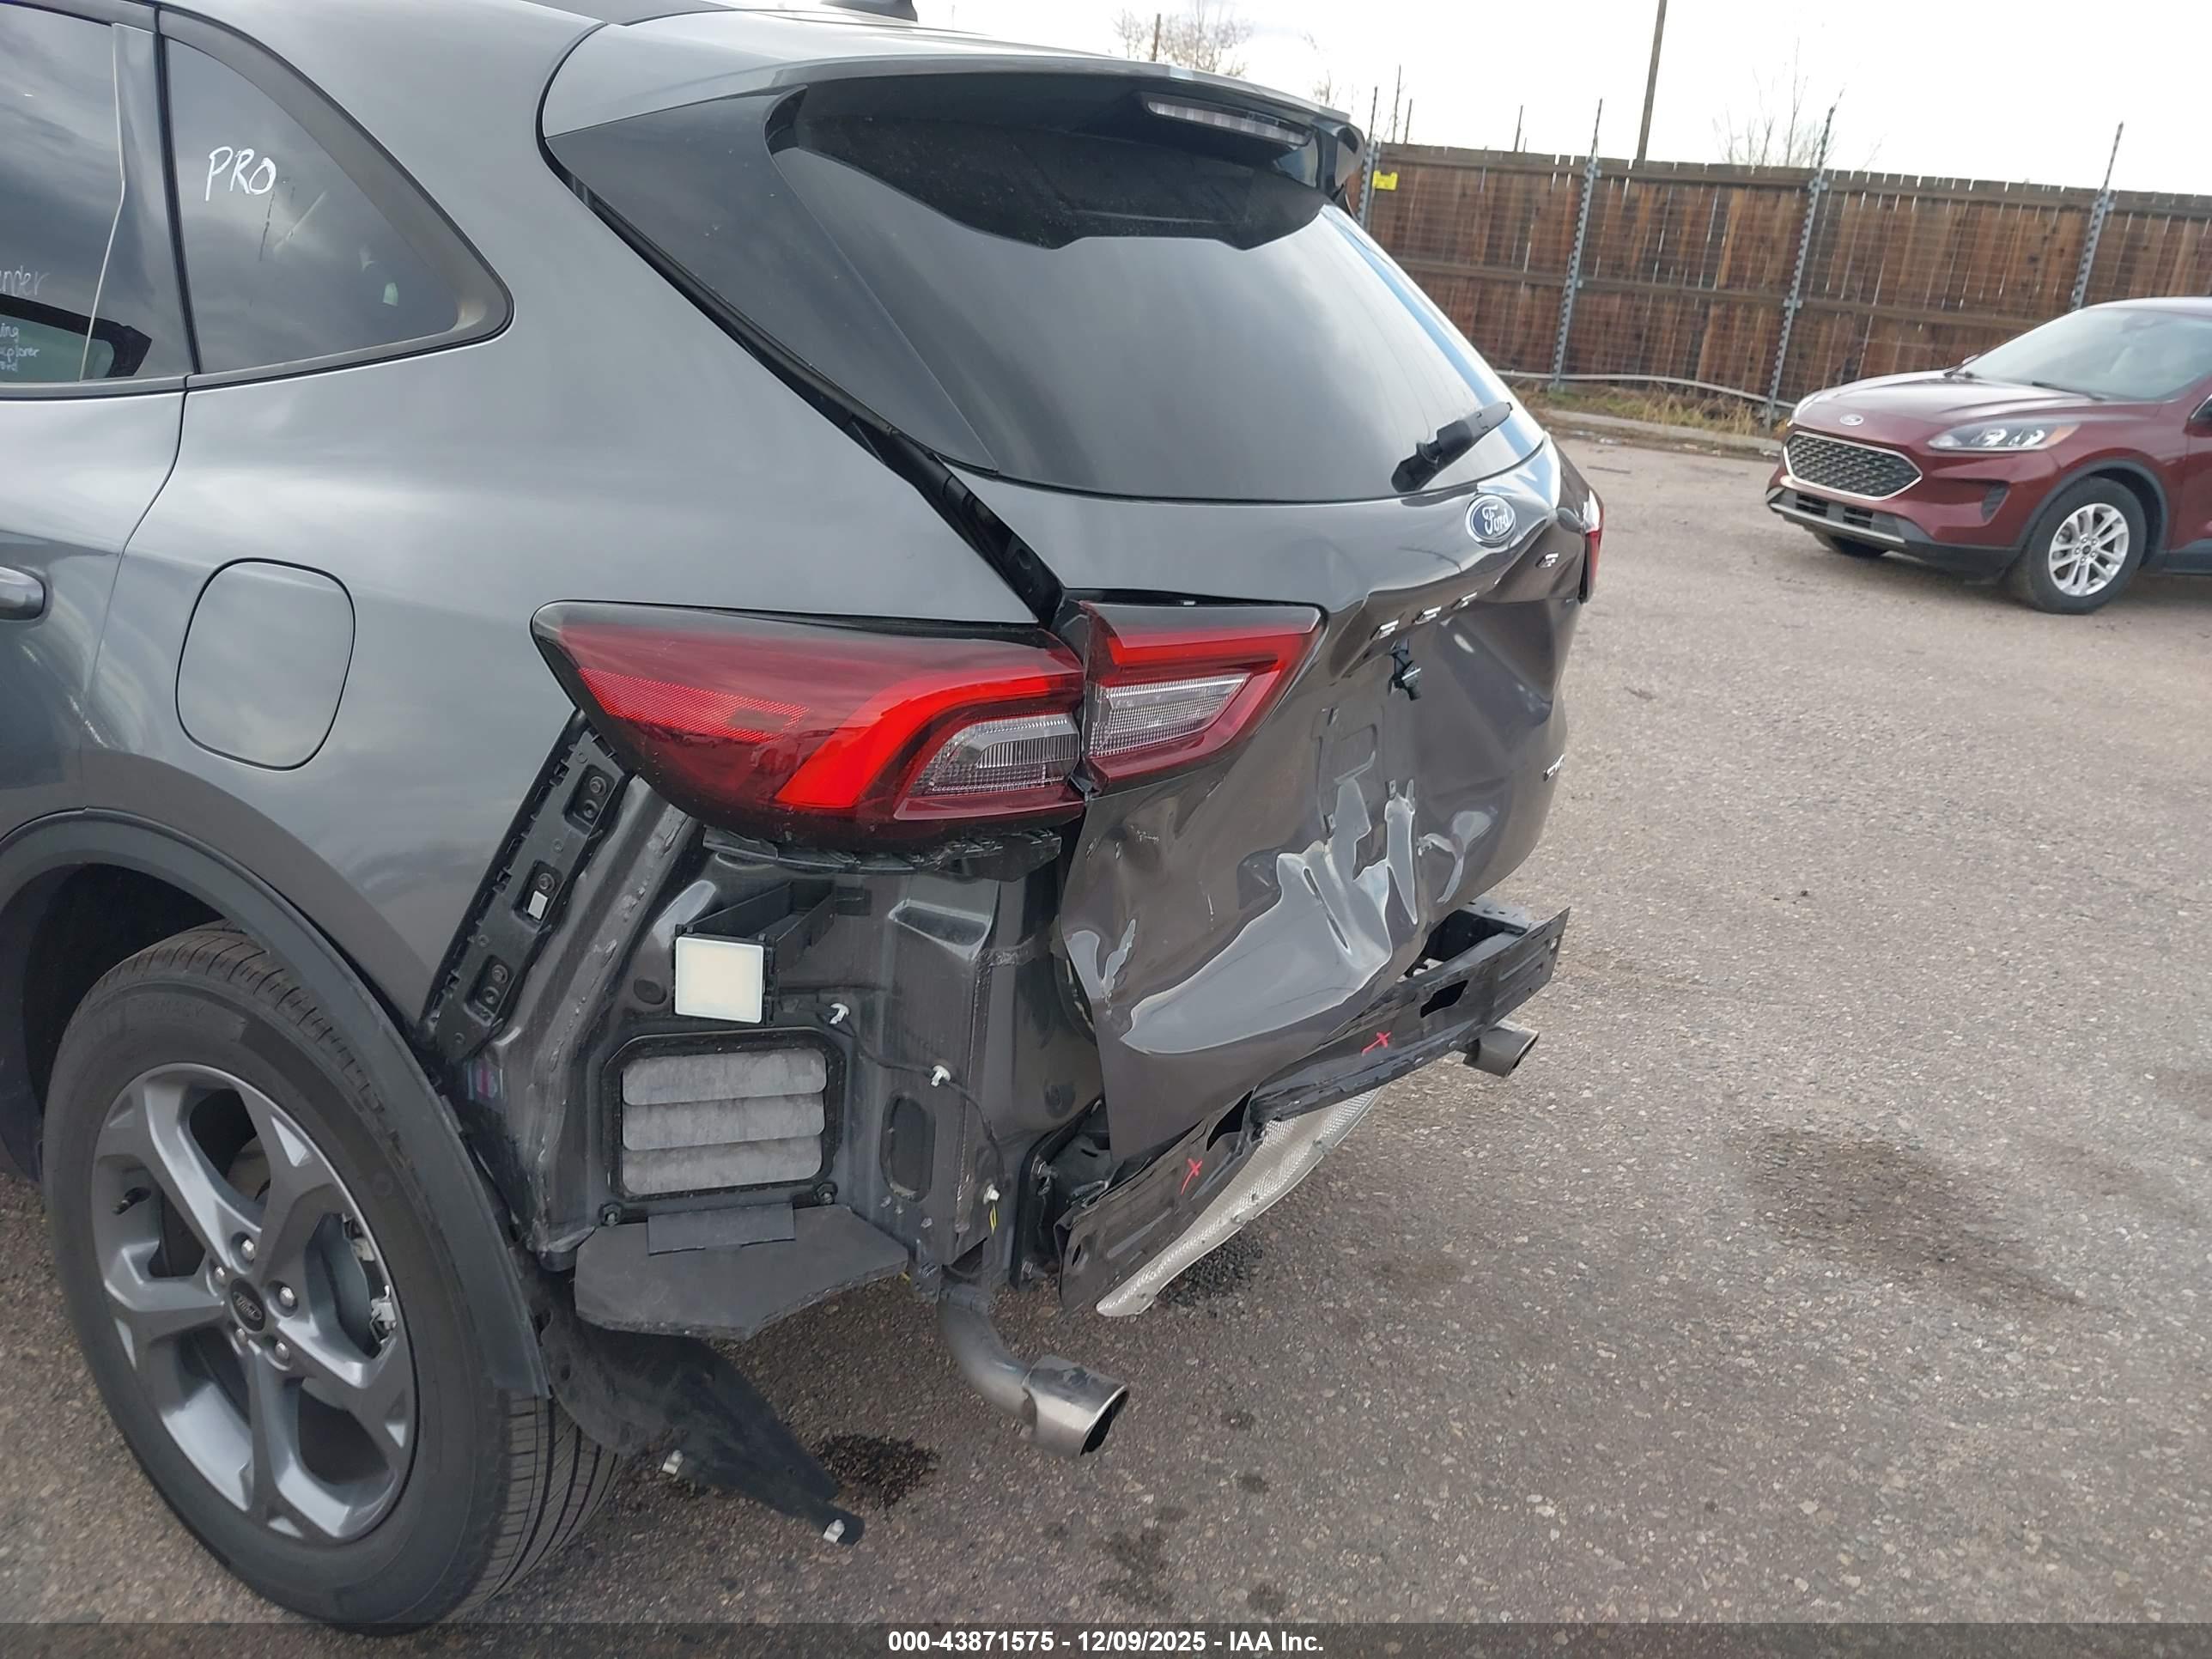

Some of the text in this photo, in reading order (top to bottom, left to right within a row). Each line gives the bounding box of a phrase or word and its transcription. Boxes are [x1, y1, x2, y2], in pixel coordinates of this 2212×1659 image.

[204, 146, 276, 202] PRO
[0, 264, 51, 296] nder
[1480, 504, 1511, 535] Ford
